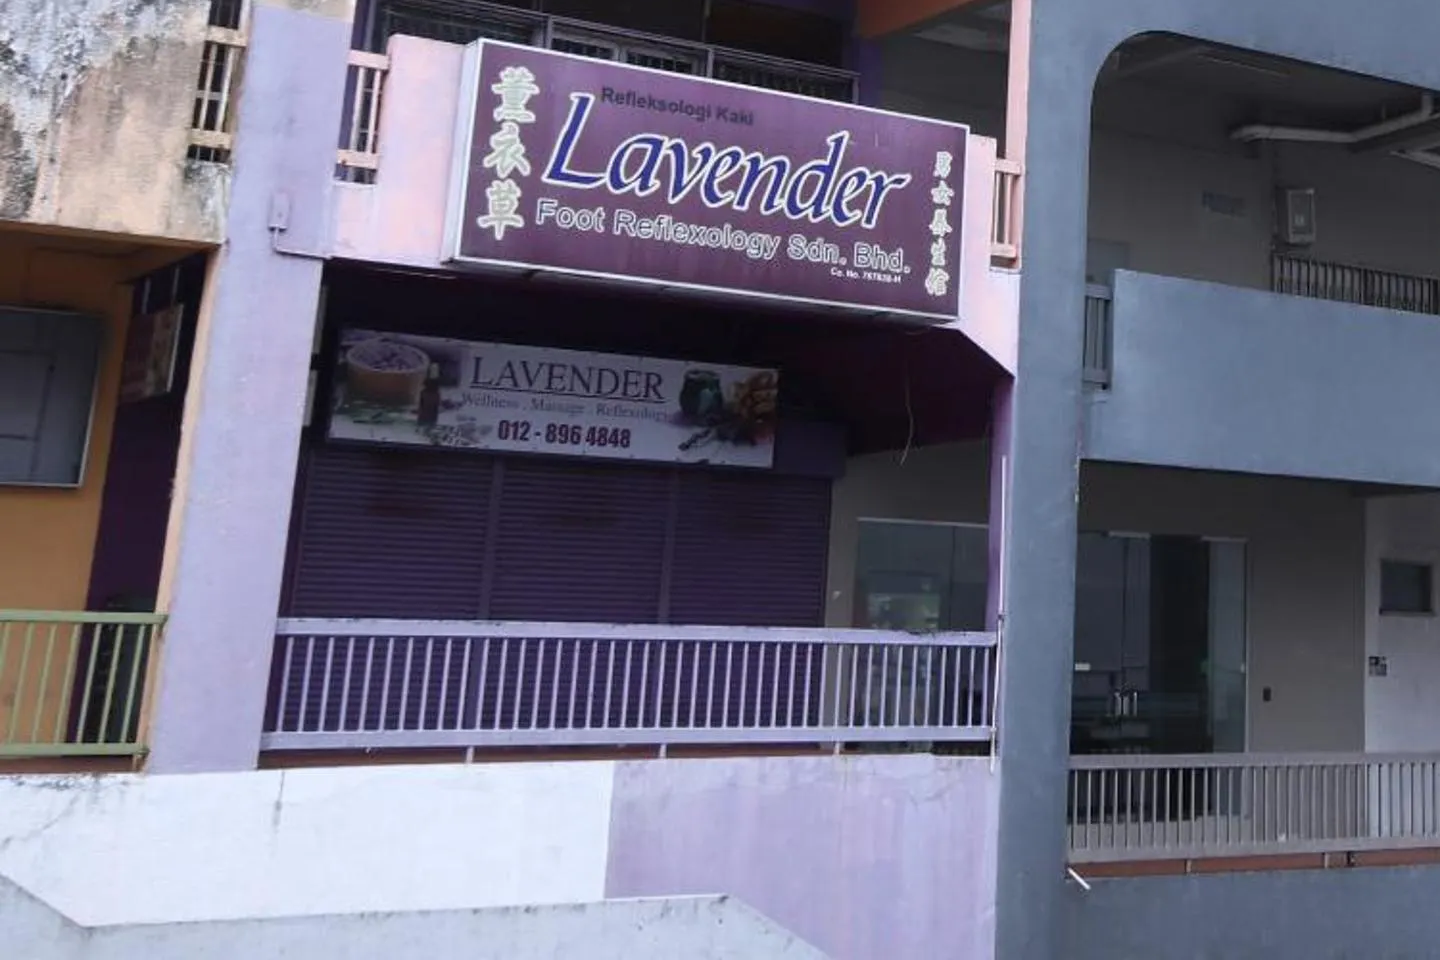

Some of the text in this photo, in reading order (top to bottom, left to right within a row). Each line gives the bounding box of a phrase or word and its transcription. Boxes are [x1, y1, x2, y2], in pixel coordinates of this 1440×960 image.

[601, 87, 754, 127] Refleksologi Kaki
[477, 66, 541, 241] 薰衣草
[541, 92, 912, 229] Lavender
[536, 198, 911, 274] Foot Reflexology Sdn. Bhd.
[471, 356, 665, 400] LAVENDER
[498, 419, 530, 441] 012
[545, 423, 582, 445] 896
[585, 426, 631, 449] 4848
